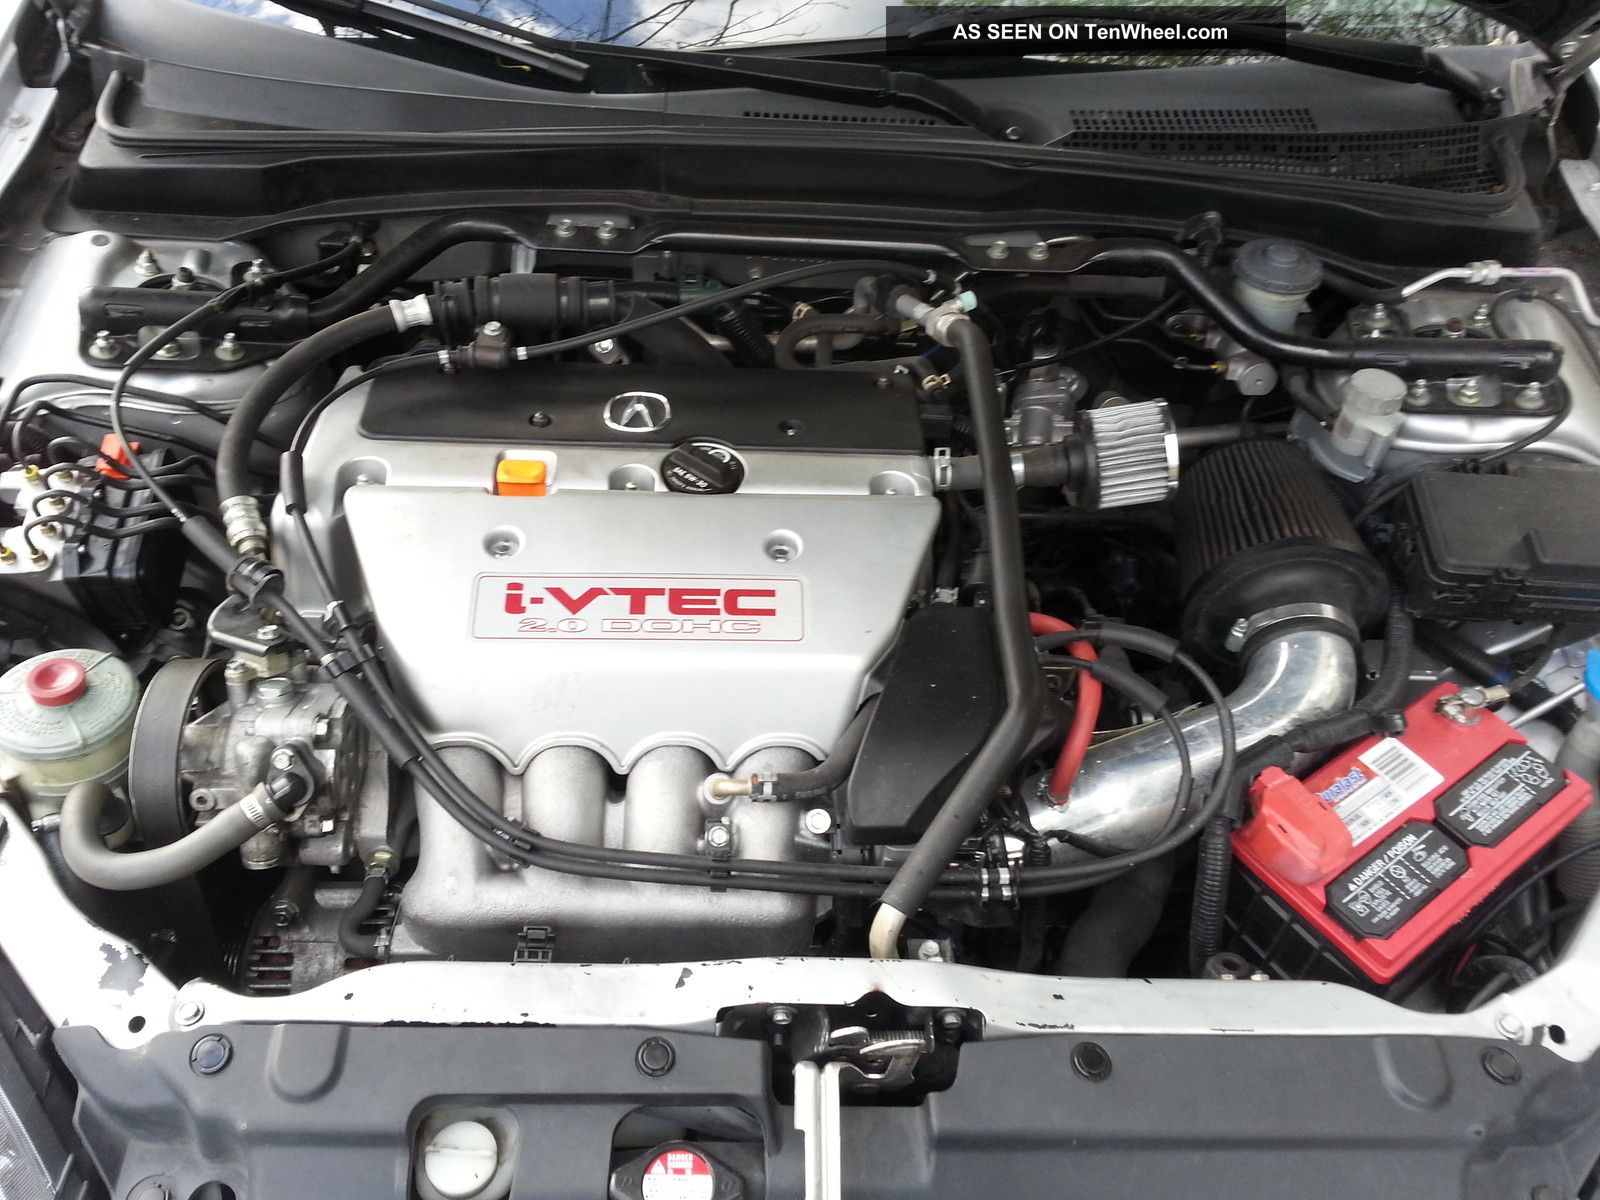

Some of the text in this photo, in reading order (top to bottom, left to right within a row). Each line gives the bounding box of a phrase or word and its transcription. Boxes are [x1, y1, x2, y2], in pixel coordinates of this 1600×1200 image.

[505, 582, 776, 616] i-VTEC
[517, 617, 761, 635] 2.0 DOHC
[1317, 766, 1366, 803] uralast
[1352, 859, 1386, 886] DANGER
[1386, 833, 1418, 859] POISON
